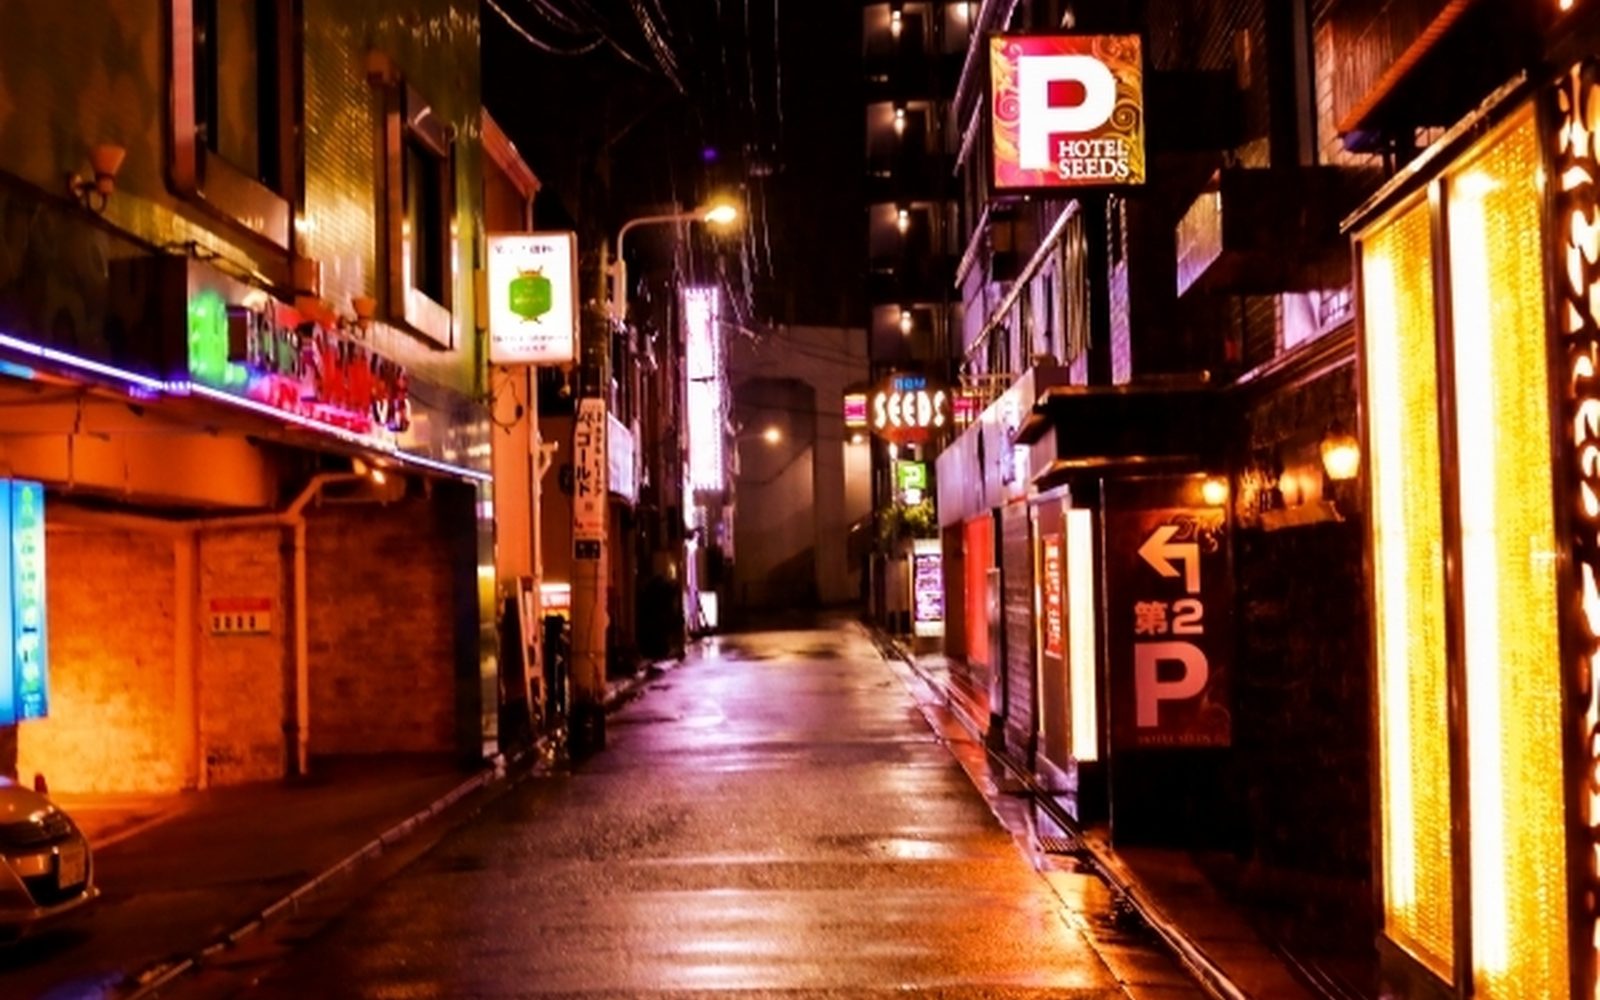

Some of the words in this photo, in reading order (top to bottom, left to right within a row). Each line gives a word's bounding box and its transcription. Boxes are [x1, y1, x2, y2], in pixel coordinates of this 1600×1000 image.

[1018, 54, 1117, 170] P
[1058, 139, 1128, 158] HOTEL
[1058, 158, 1129, 180] SEEDS
[874, 390, 946, 429] SEEDS
[1134, 599, 1204, 635] 第2
[1134, 641, 1209, 727] P
